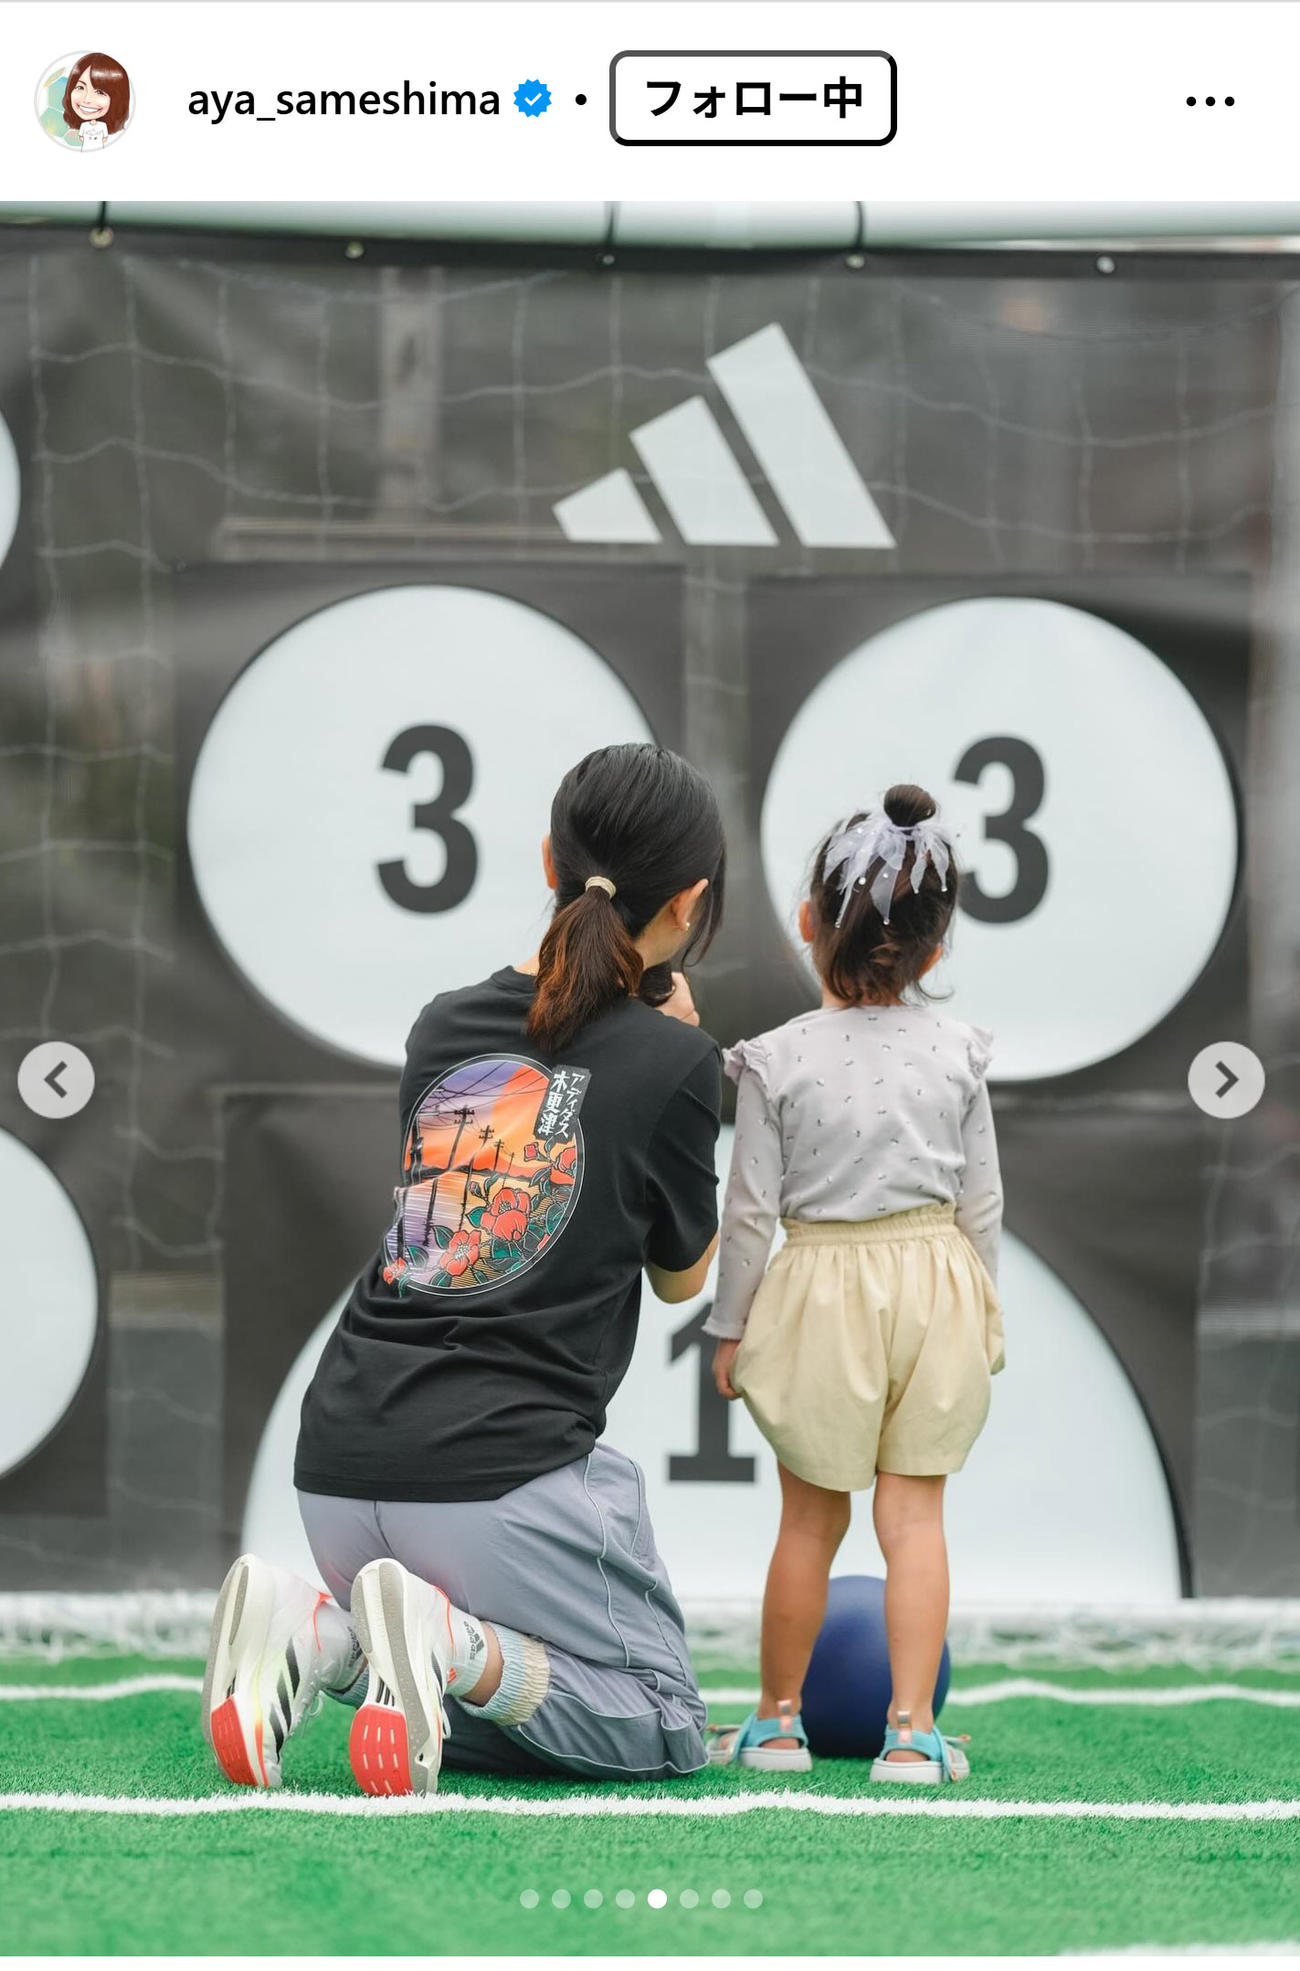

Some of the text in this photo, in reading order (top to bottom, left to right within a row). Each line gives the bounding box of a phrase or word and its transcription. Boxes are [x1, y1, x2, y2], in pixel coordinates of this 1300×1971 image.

[377, 724, 480, 915] 3
[955, 736, 1050, 925] 3
[538, 1071, 570, 1135] 木更津
[668, 1300, 755, 1482] 1
